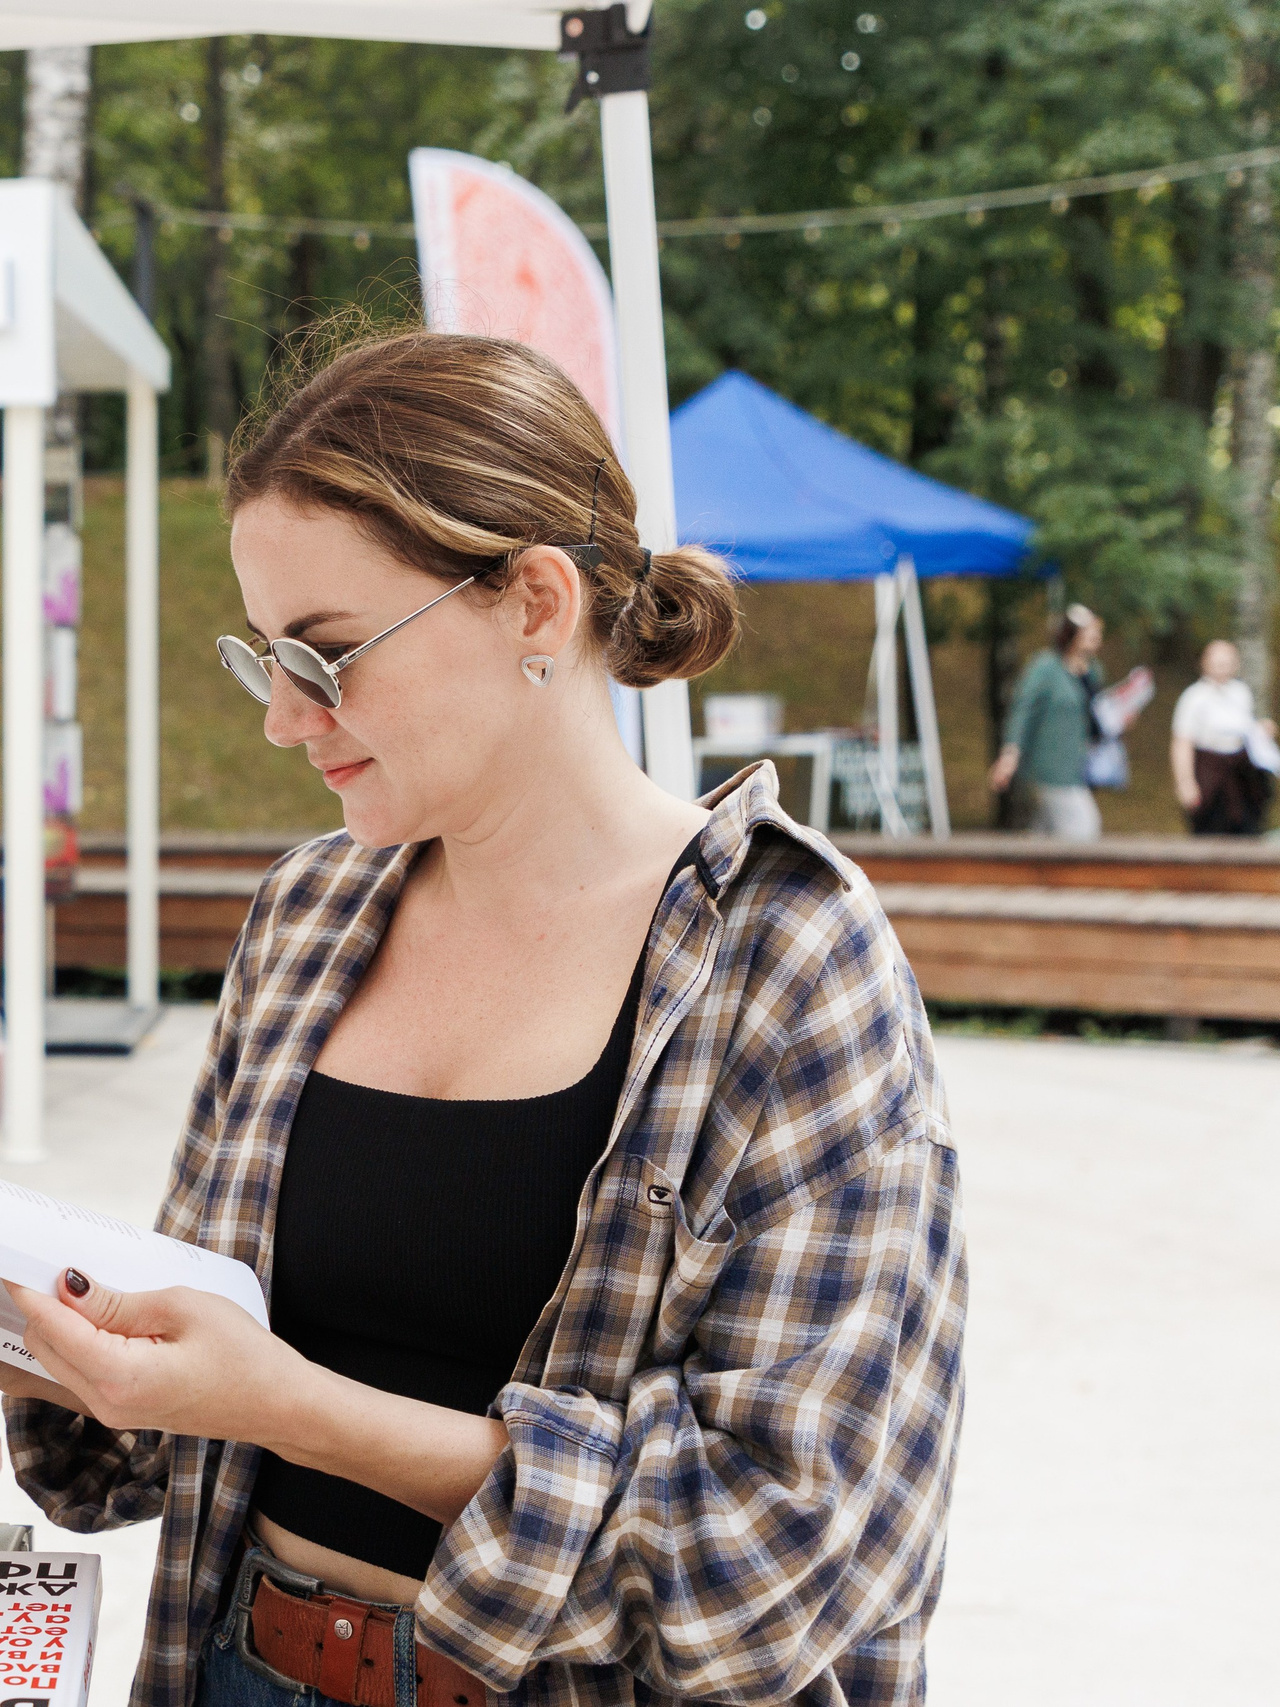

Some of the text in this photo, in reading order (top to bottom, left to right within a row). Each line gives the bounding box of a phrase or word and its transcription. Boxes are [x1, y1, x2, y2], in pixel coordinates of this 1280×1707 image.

[1, 1340, 37, 1363] ЙПЛЗ
[7, 1602, 72, 1613] нет
[12, 1611, 37, 1623] у
[45, 1614, 71, 1624] а
[43, 1636, 65, 1648] у
[40, 1651, 63, 1661] и
